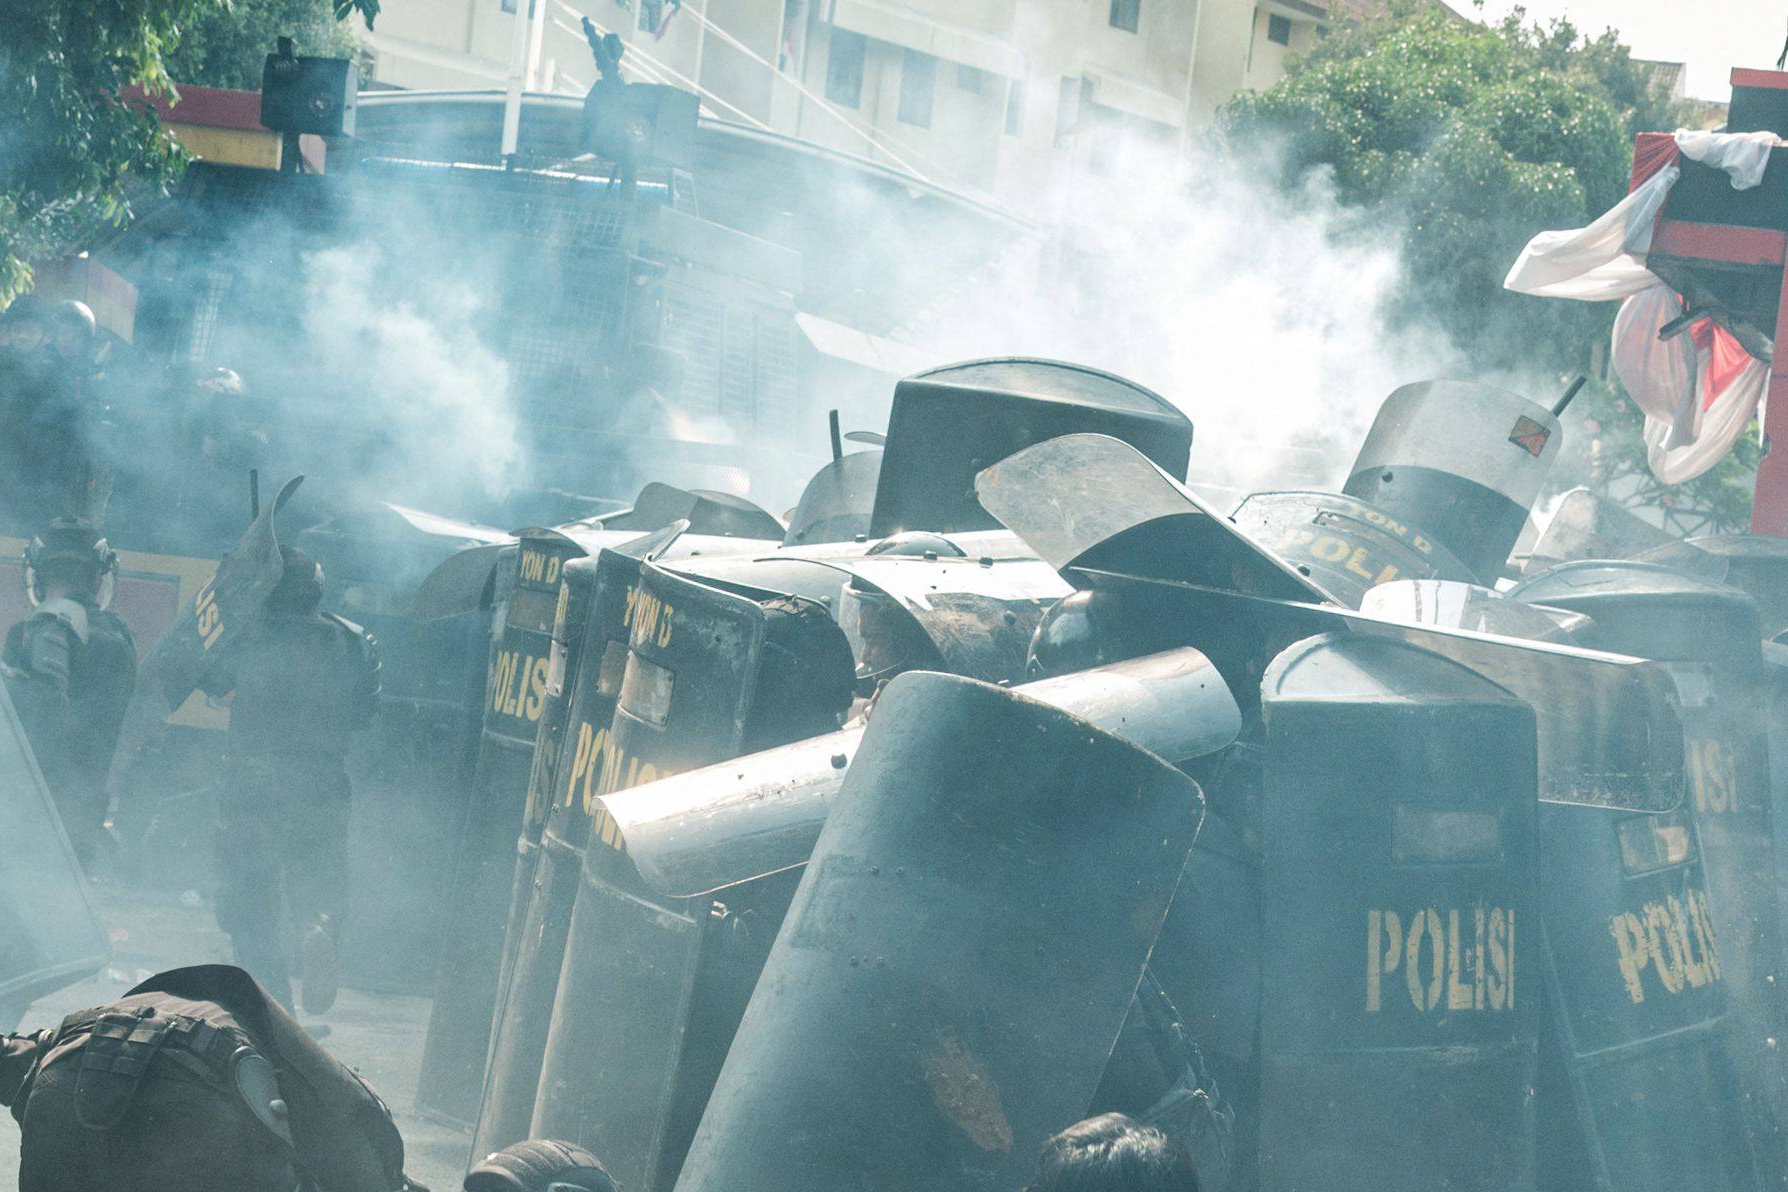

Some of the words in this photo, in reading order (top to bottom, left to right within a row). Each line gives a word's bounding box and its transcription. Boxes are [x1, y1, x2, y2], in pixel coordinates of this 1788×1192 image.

[520, 550, 545, 582] YON
[545, 555, 560, 584] D
[1366, 907, 1514, 1012] POLISI
